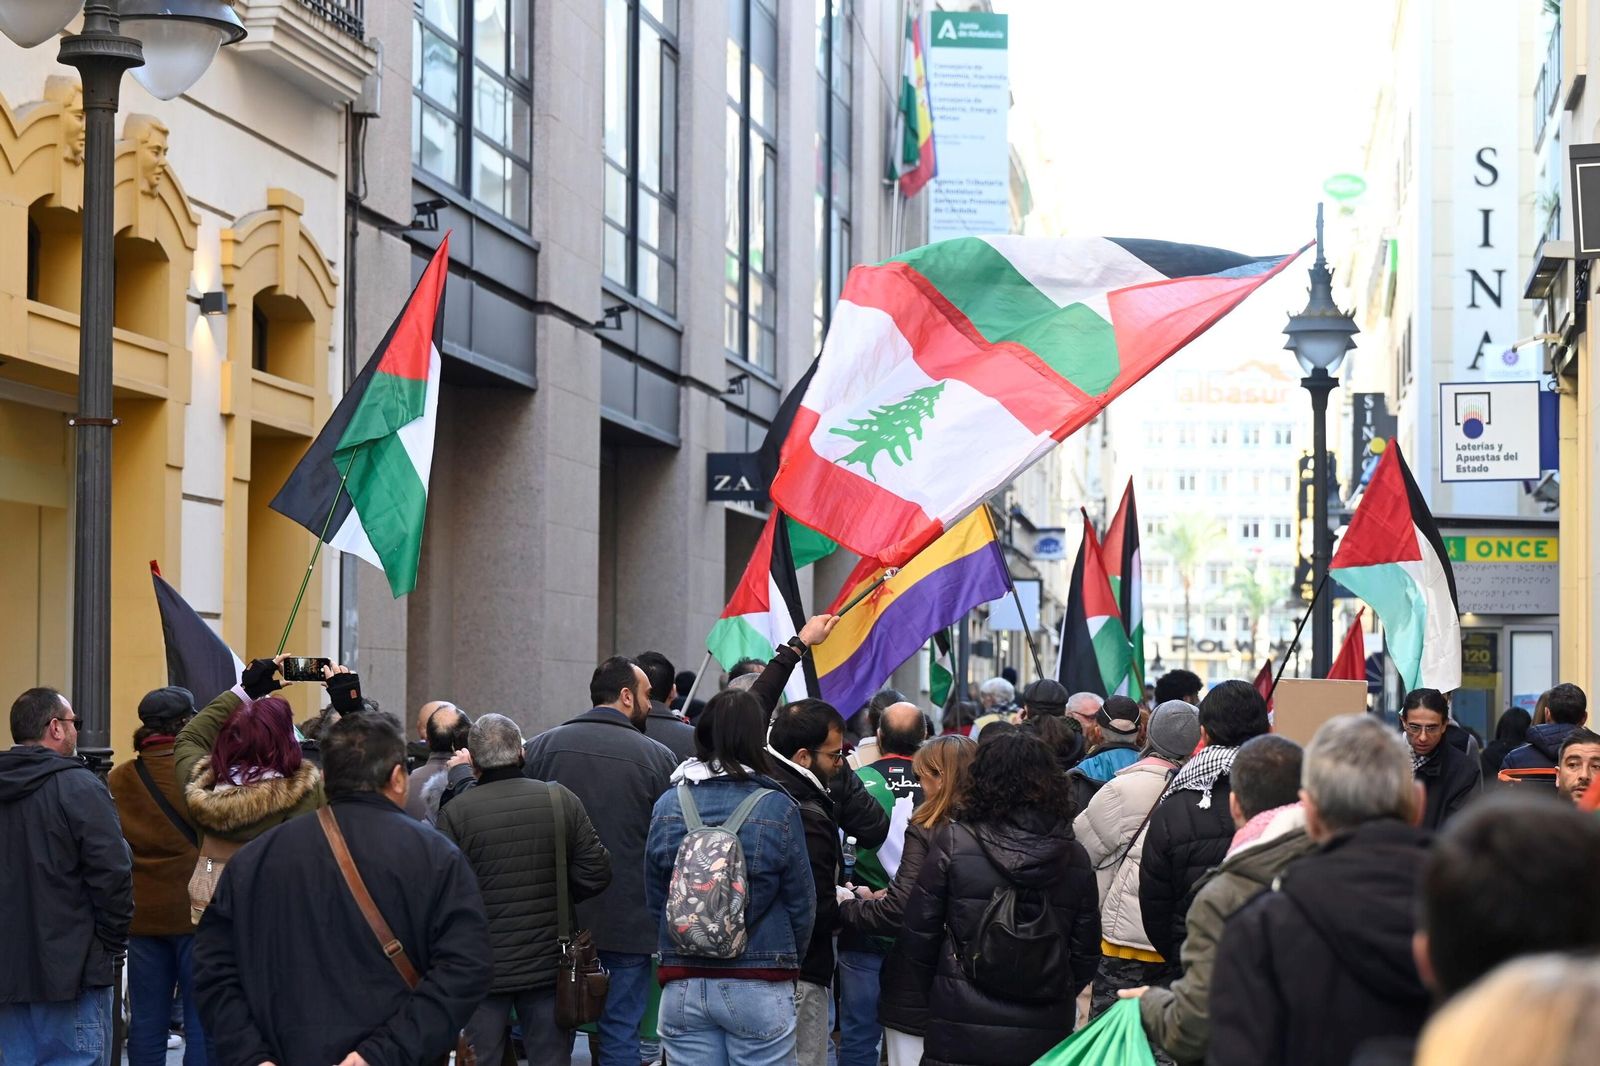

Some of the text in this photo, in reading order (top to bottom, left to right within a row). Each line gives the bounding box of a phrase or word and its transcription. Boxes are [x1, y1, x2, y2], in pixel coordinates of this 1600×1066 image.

[1455, 442, 1503, 452] Loterías y
[1456, 452, 1518, 463] Apuestas del
[1456, 464, 1489, 473] Estado
[1476, 540, 1549, 558] ONCE
